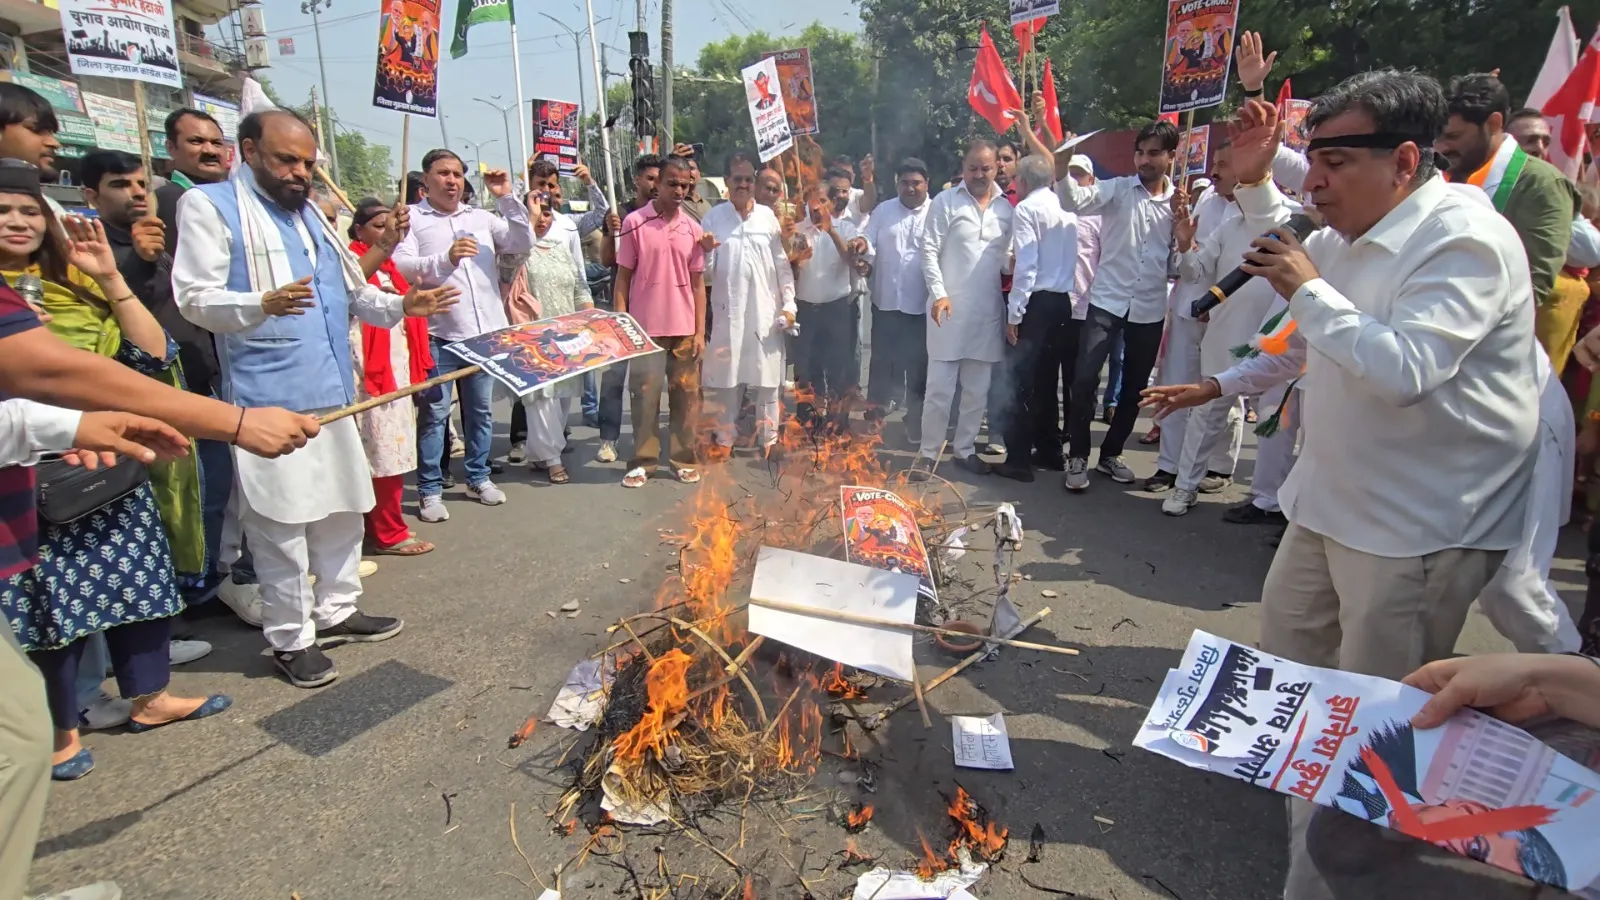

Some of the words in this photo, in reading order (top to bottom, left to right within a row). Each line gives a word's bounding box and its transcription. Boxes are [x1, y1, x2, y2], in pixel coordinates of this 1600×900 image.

[69, 10, 104, 27] चुनाव
[107, 15, 142, 32] आयोग
[143, 22, 170, 40] बचाओ
[139, 0, 165, 16] हटाओ
[77, 57, 102, 69] जिला
[1188, 644, 1220, 685] जिला
[1266, 682, 1313, 733] चुनाव
[1312, 695, 1361, 761] ज्ञानेश
